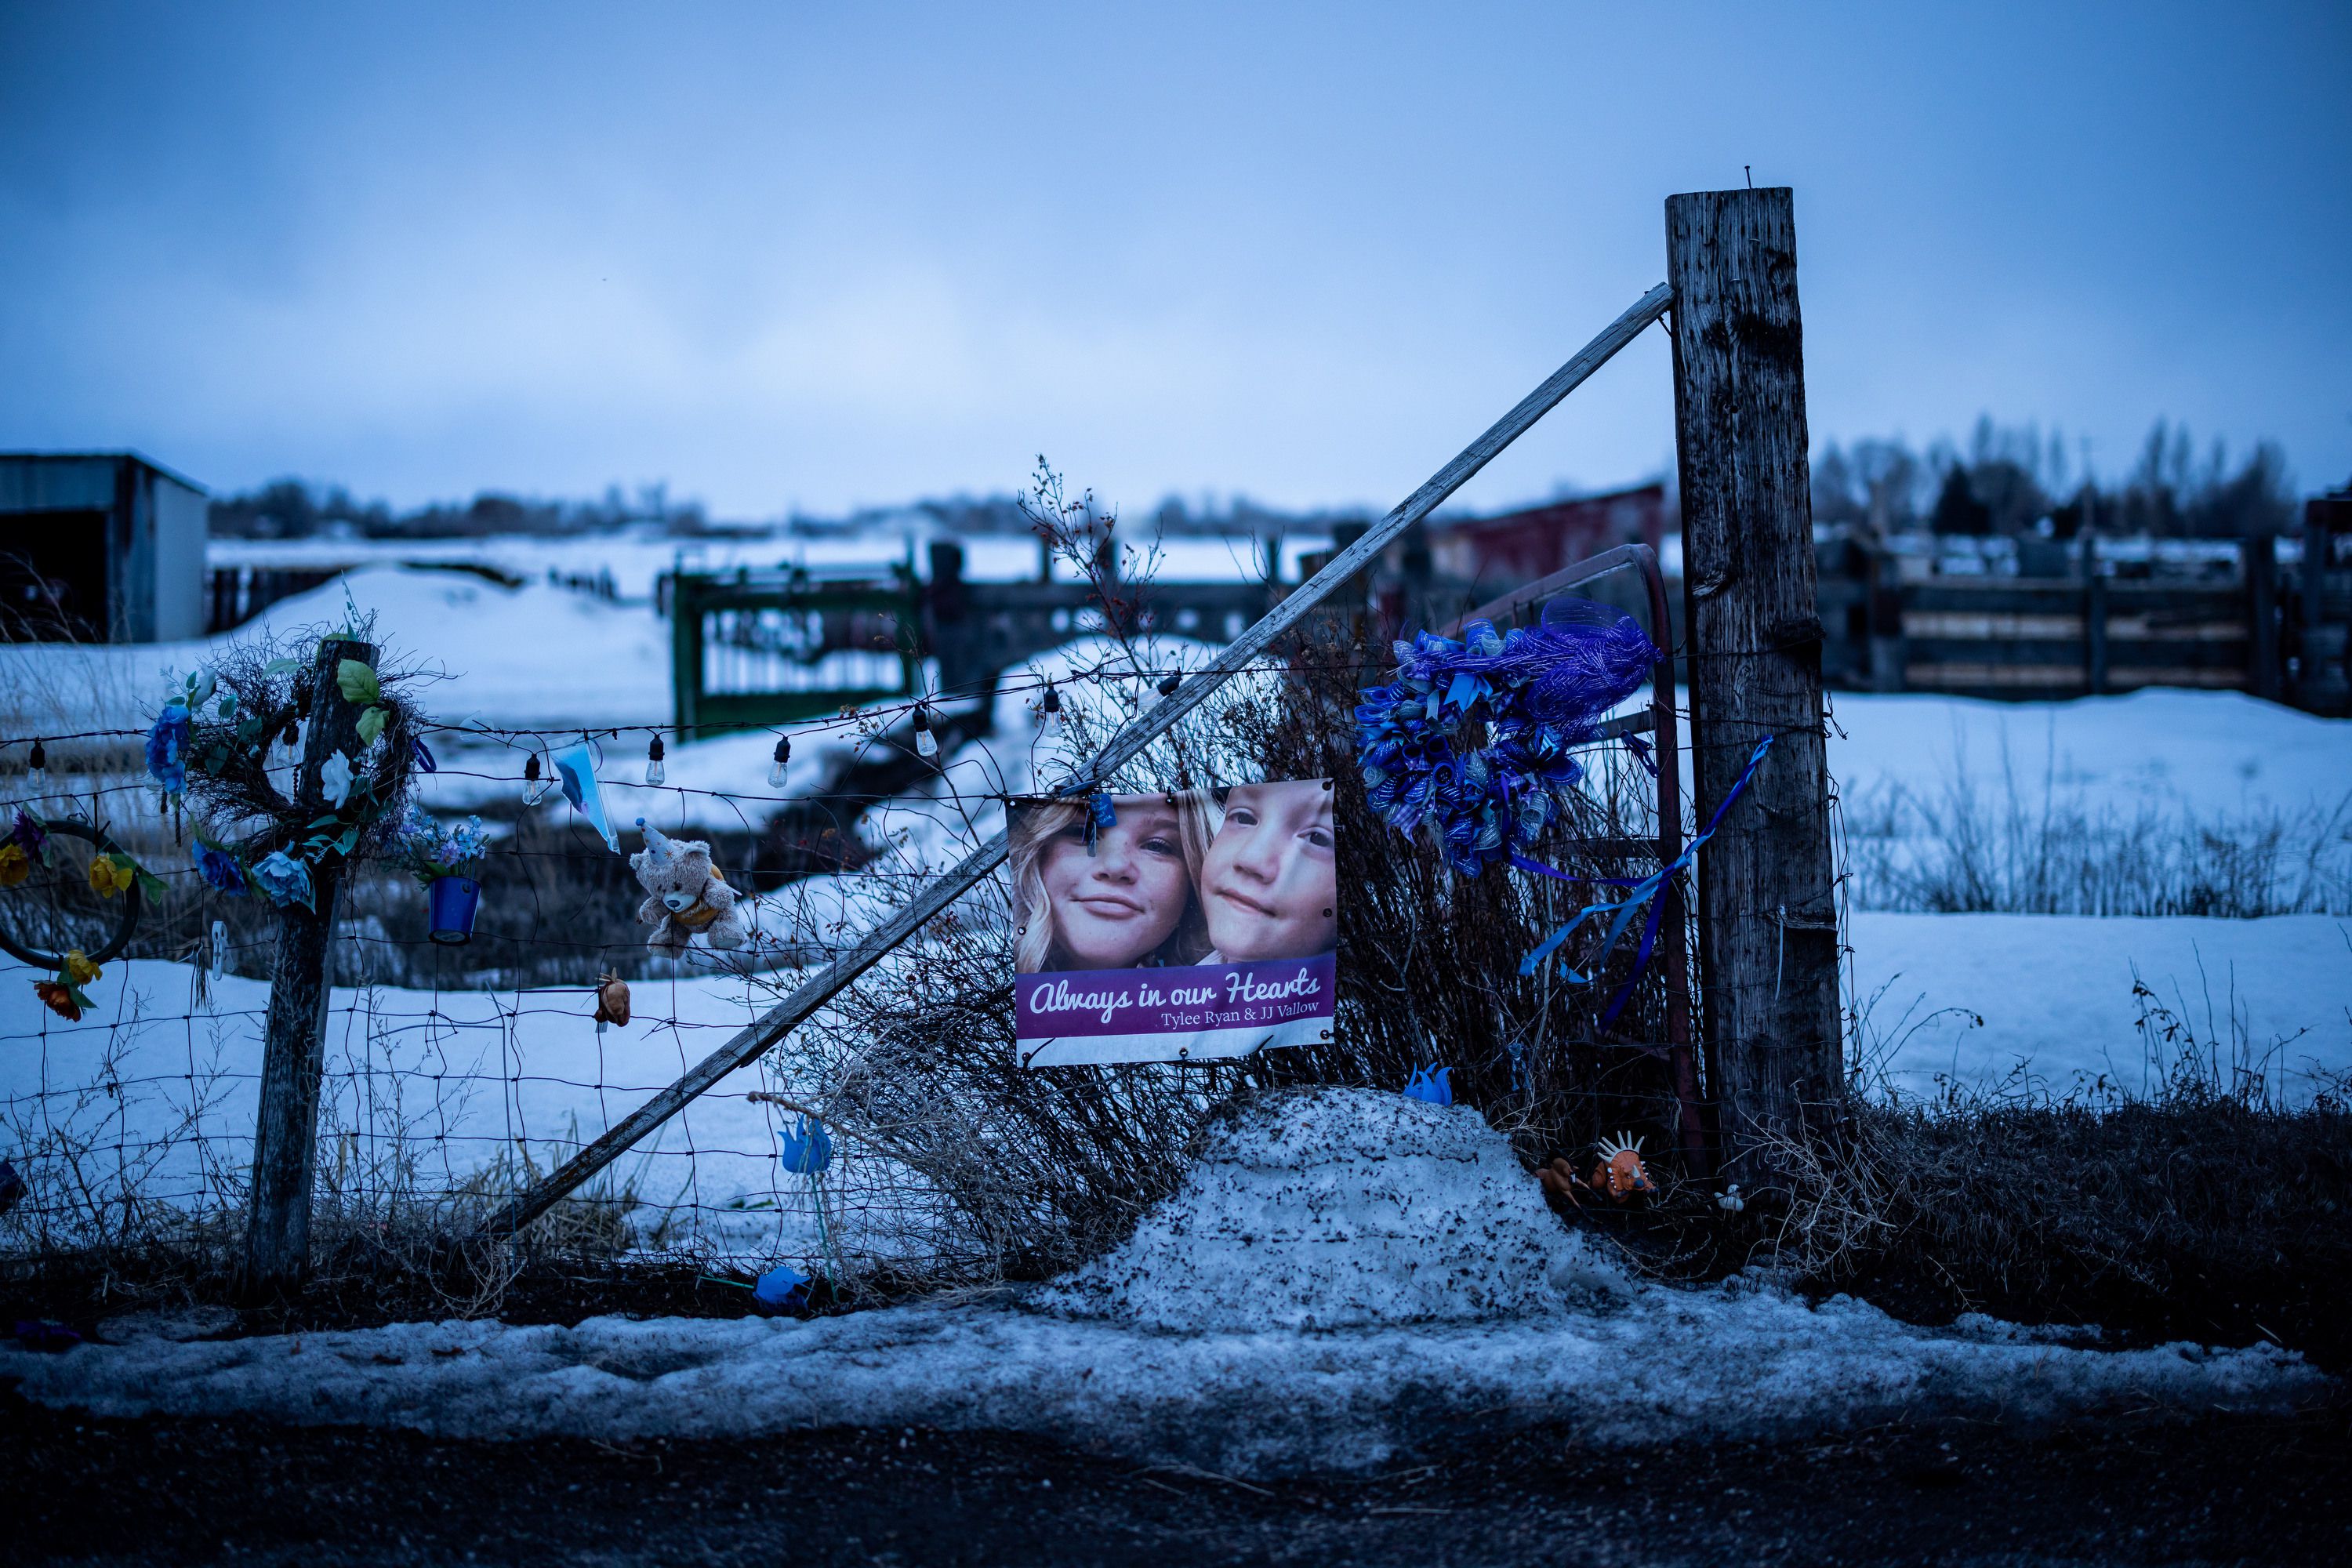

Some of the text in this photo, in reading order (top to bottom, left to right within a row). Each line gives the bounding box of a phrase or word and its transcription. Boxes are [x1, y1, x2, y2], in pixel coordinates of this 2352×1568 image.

[1029, 967, 1321, 1024] Always in our Hearts
[1160, 1002, 1319, 1030] Tylee Ryan & JJ Vallow
